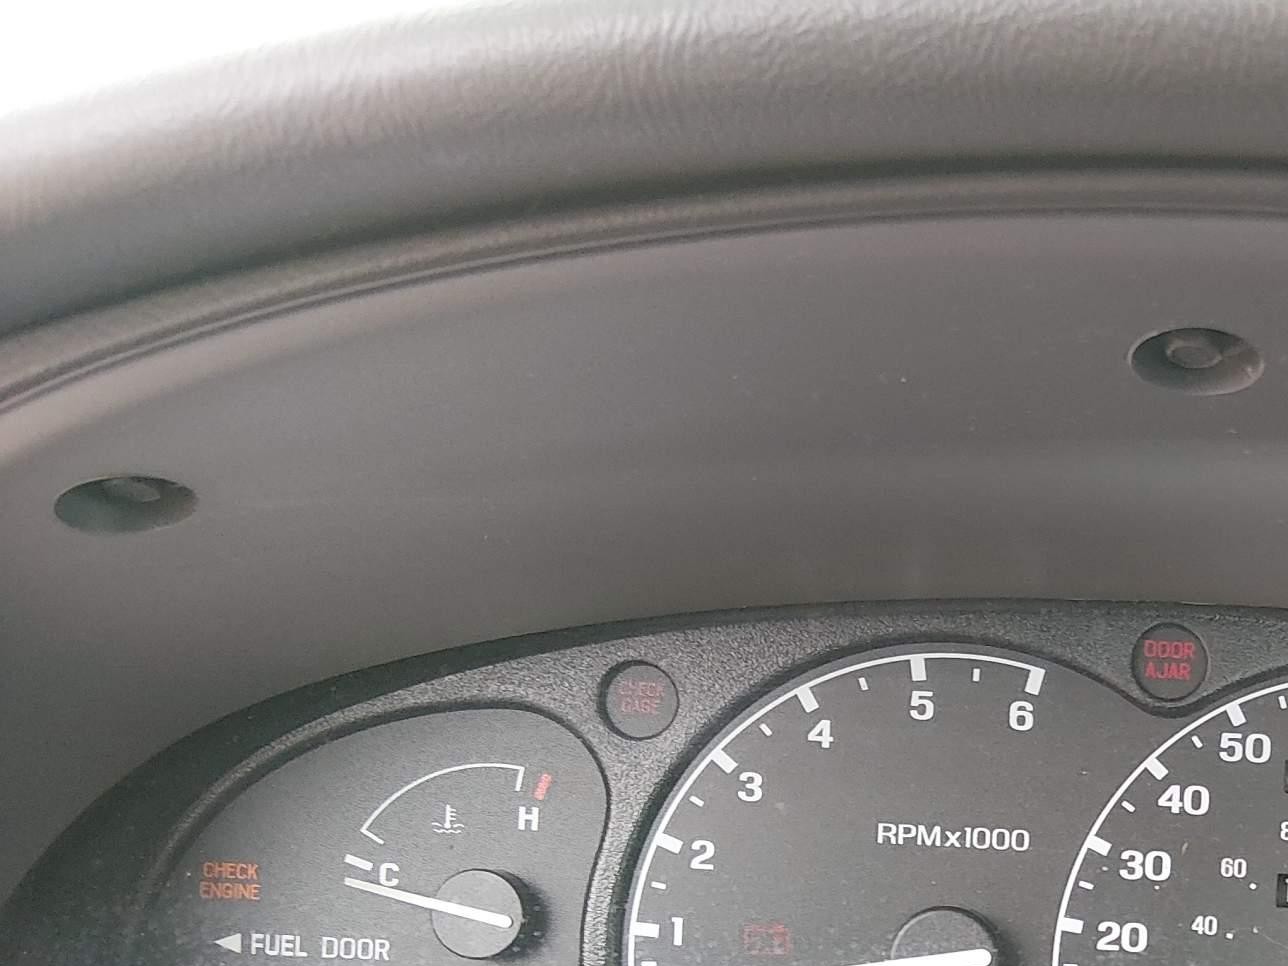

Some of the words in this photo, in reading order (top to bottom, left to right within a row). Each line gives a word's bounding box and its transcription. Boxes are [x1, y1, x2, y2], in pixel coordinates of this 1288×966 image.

[1143, 640, 1195, 659] DOOR
[1145, 662, 1191, 681] AJAR
[909, 690, 934, 721] 5
[1008, 701, 1034, 731] 6
[807, 719, 834, 749] 4
[1219, 732, 1272, 764] 50
[737, 772, 763, 802] 3
[1157, 784, 1210, 816] 40
[517, 806, 540, 832] H
[877, 822, 1031, 852] RPMx1000
[690, 840, 715, 871] 2
[1119, 850, 1171, 881] 30
[1220, 858, 1247, 878] 60
[203, 862, 259, 879] CHECK
[379, 862, 400, 887] C
[200, 882, 262, 900] ENGINE
[671, 917, 683, 946] 1
[1096, 921, 1148, 953] 20
[1191, 915, 1218, 936] 40
[251, 933, 308, 957] FUEL
[321, 936, 391, 961] DOOR
